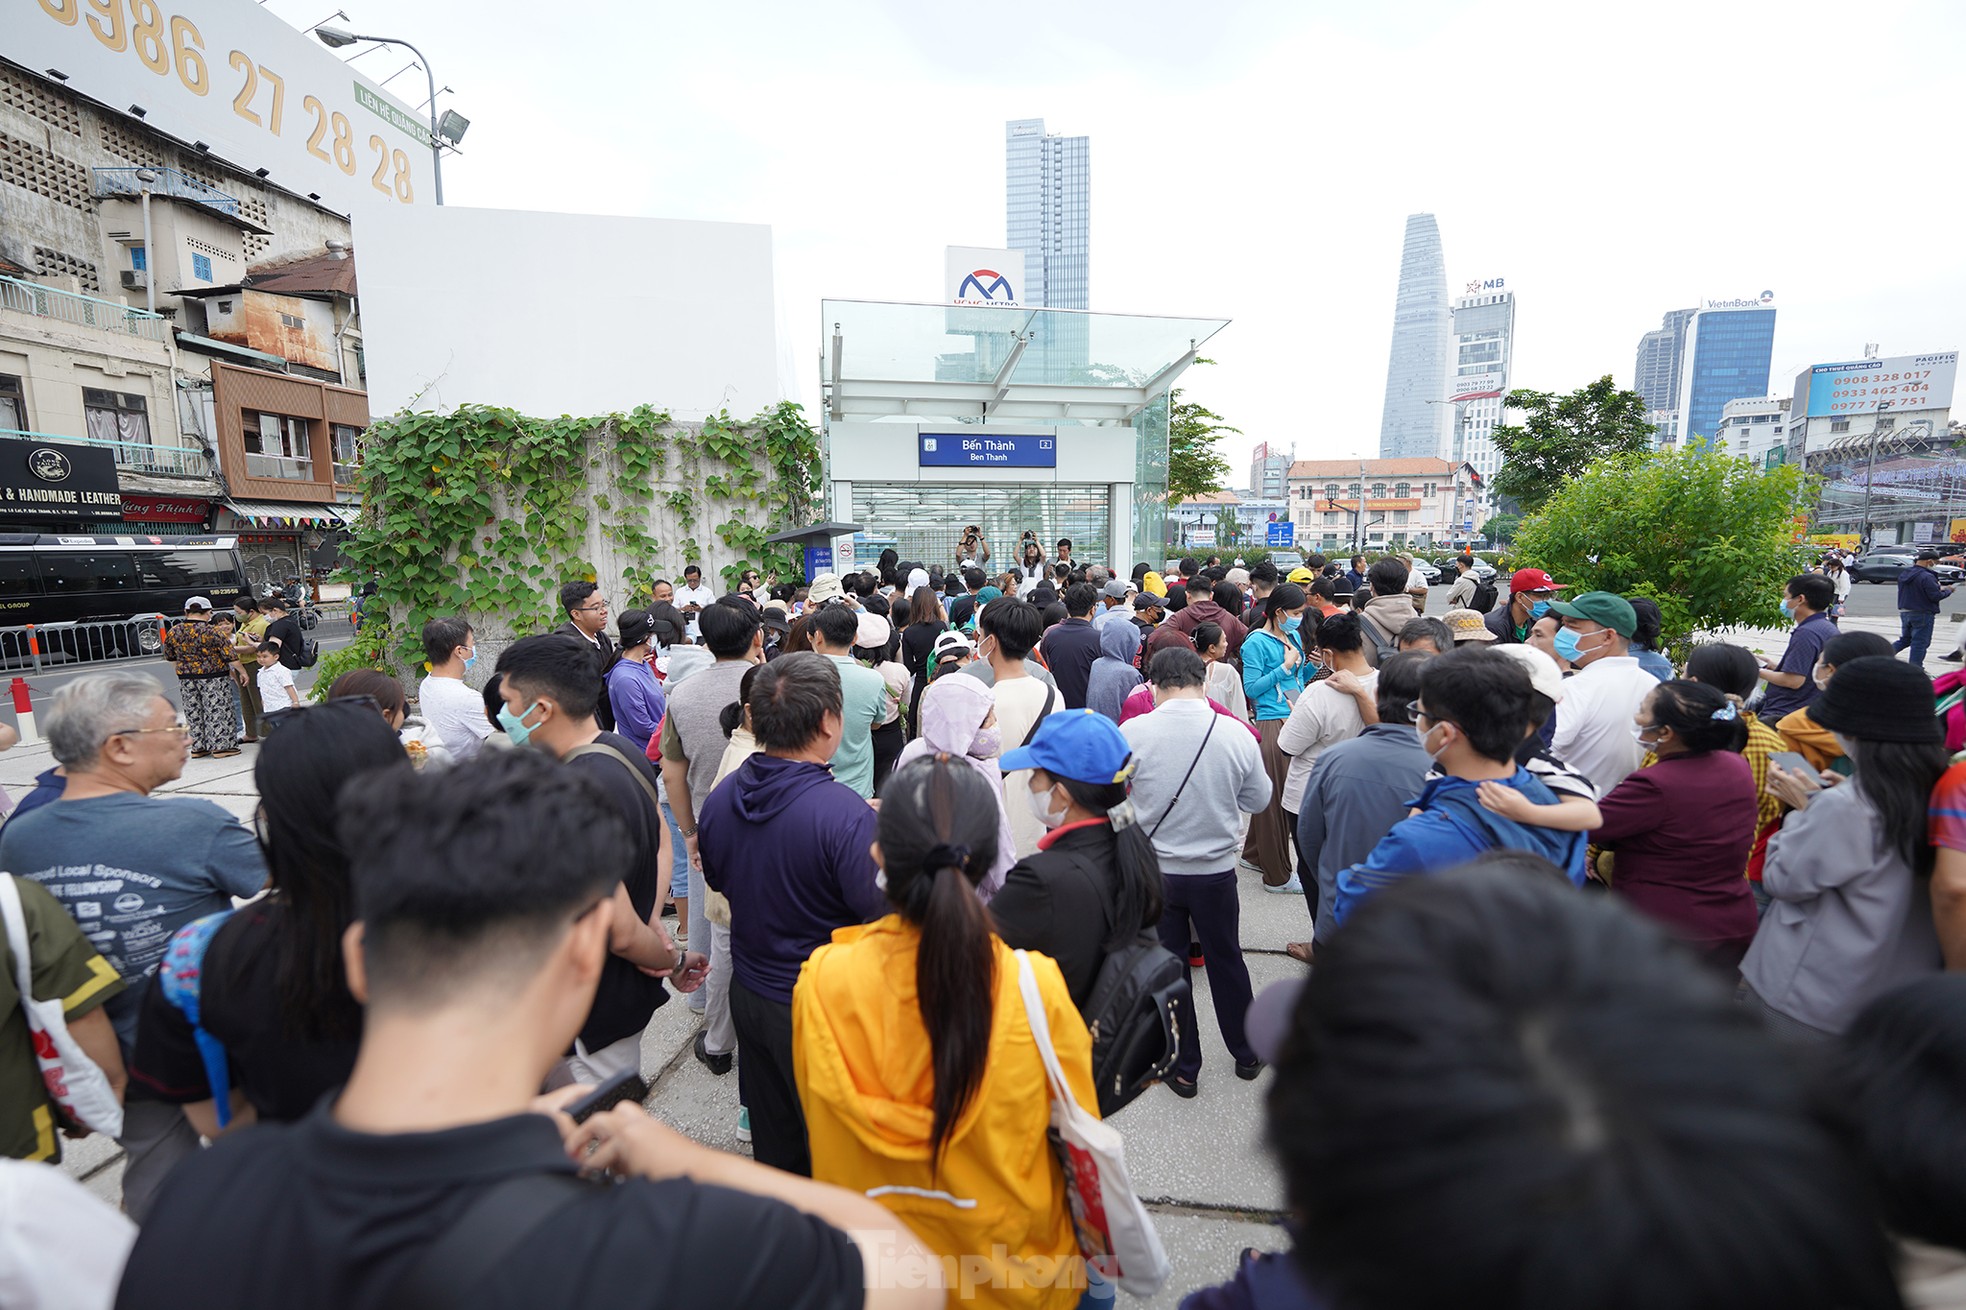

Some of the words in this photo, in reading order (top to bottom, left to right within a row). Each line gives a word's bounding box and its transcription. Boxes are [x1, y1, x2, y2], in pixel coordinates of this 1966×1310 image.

[360, 89, 379, 112] LIÊN
[379, 102, 391, 122] HỆ
[391, 111, 417, 136] QUẢNG
[228, 49, 285, 138] 27
[303, 94, 357, 177] 28
[369, 134, 414, 204] 28
[1483, 277, 1504, 290] MB
[1707, 297, 1760, 309] VietinBank
[1868, 361, 1881, 369] CÁO
[1915, 354, 1955, 362] PACIFIC
[1834, 375, 1869, 386] 0908
[1872, 372, 1900, 383] 328
[1903, 370, 1931, 380] 017
[1832, 388, 1867, 399] 0933
[1871, 385, 1898, 396] 462
[1901, 383, 1930, 394] 404
[1831, 401, 1866, 411] 0977
[1900, 396, 1927, 406] 751
[962, 439, 982, 450] Bến
[984, 440, 1015, 451] Thành
[970, 453, 984, 461] Ben
[985, 453, 1008, 461] Thanh
[6, 487, 15, 501] &
[18, 488, 78, 504] HANDMADE
[80, 491, 121, 506] LEATHER
[155, 503, 193, 516] Thịnh
[58, 863, 92, 878] Local
[93, 864, 163, 889] Sponsors
